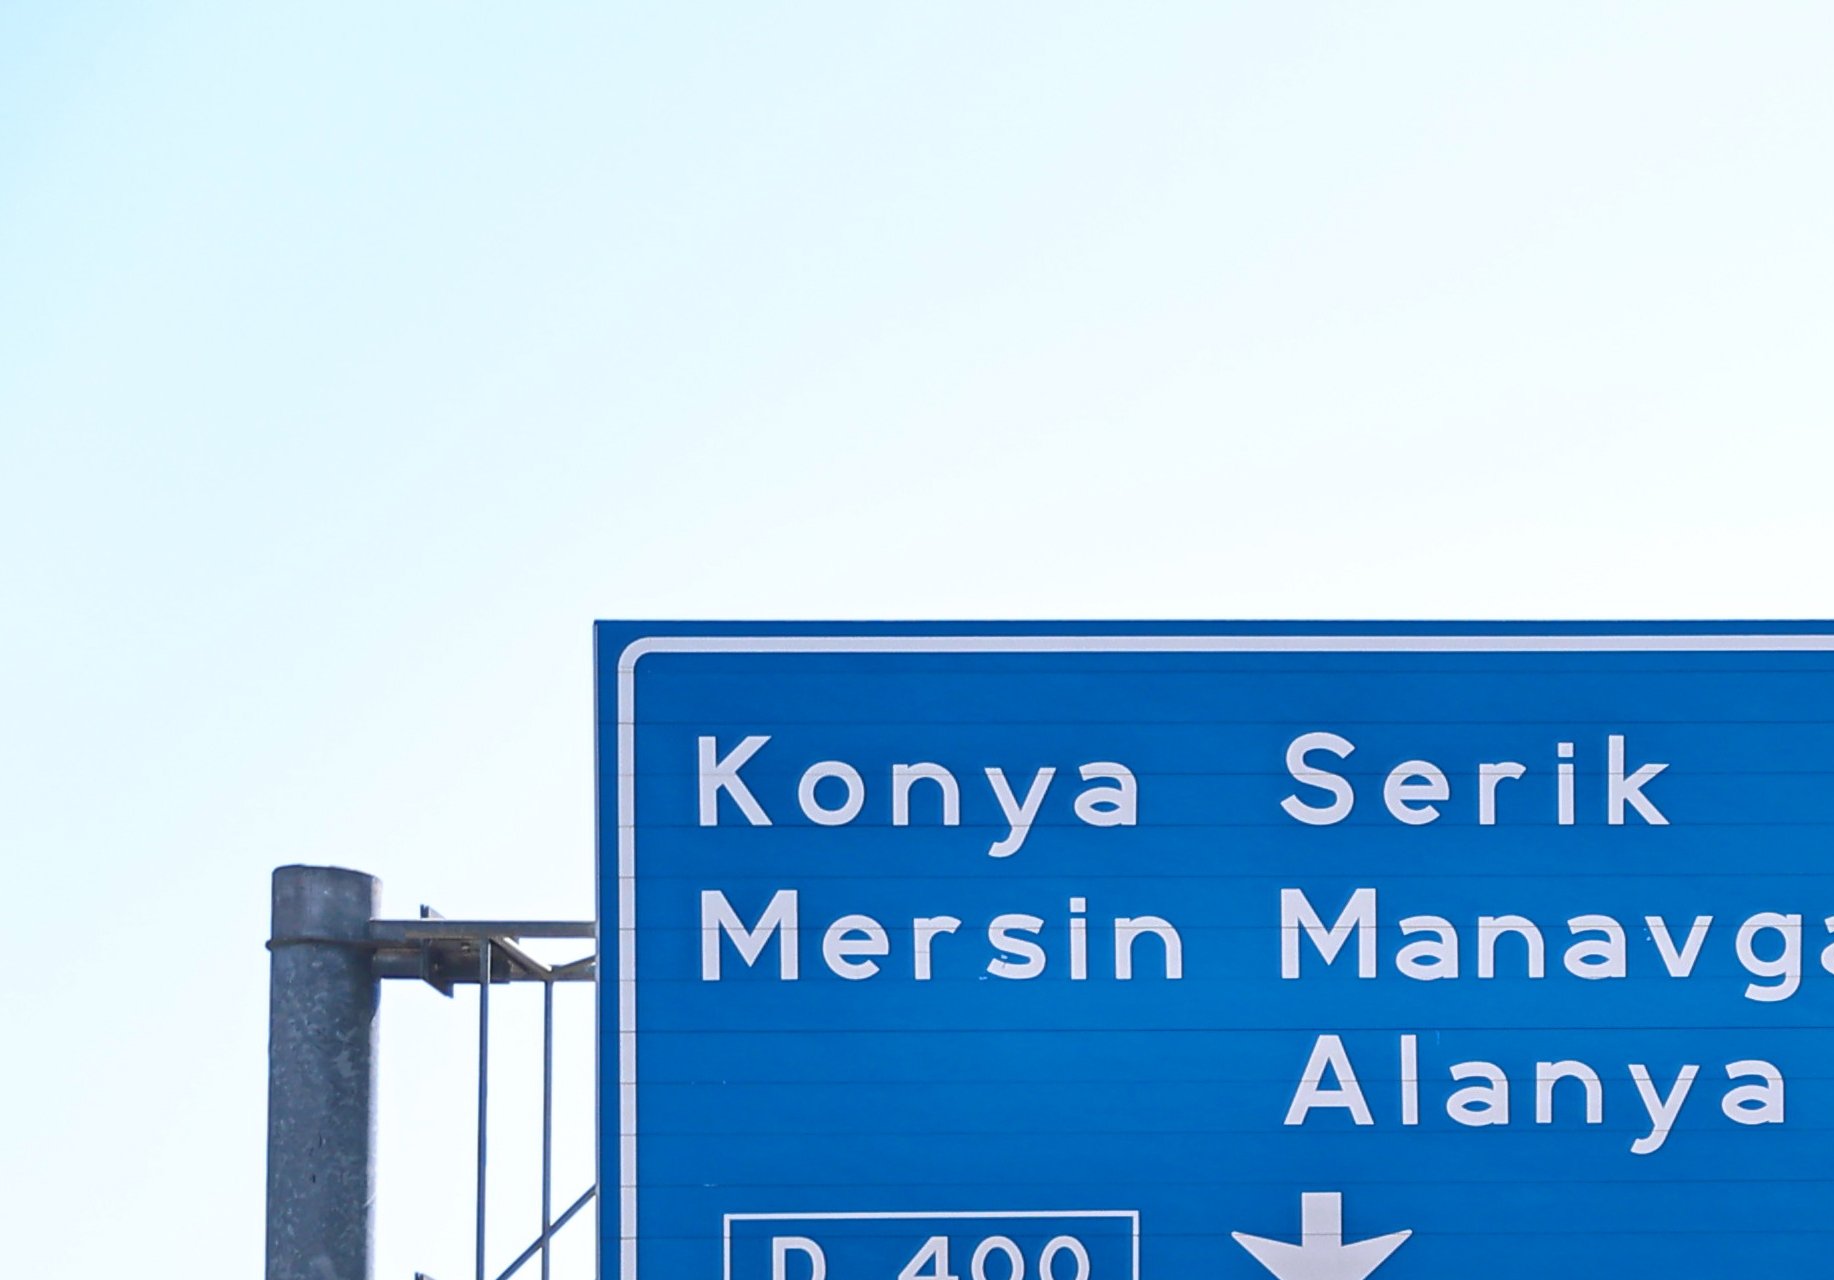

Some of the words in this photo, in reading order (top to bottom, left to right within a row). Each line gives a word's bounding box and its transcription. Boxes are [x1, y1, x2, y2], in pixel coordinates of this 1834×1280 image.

[698, 735, 1138, 858] Konya
[1279, 731, 1672, 826] Serik
[701, 889, 1184, 981] Mersin
[1283, 1034, 1785, 1154] Alanya
